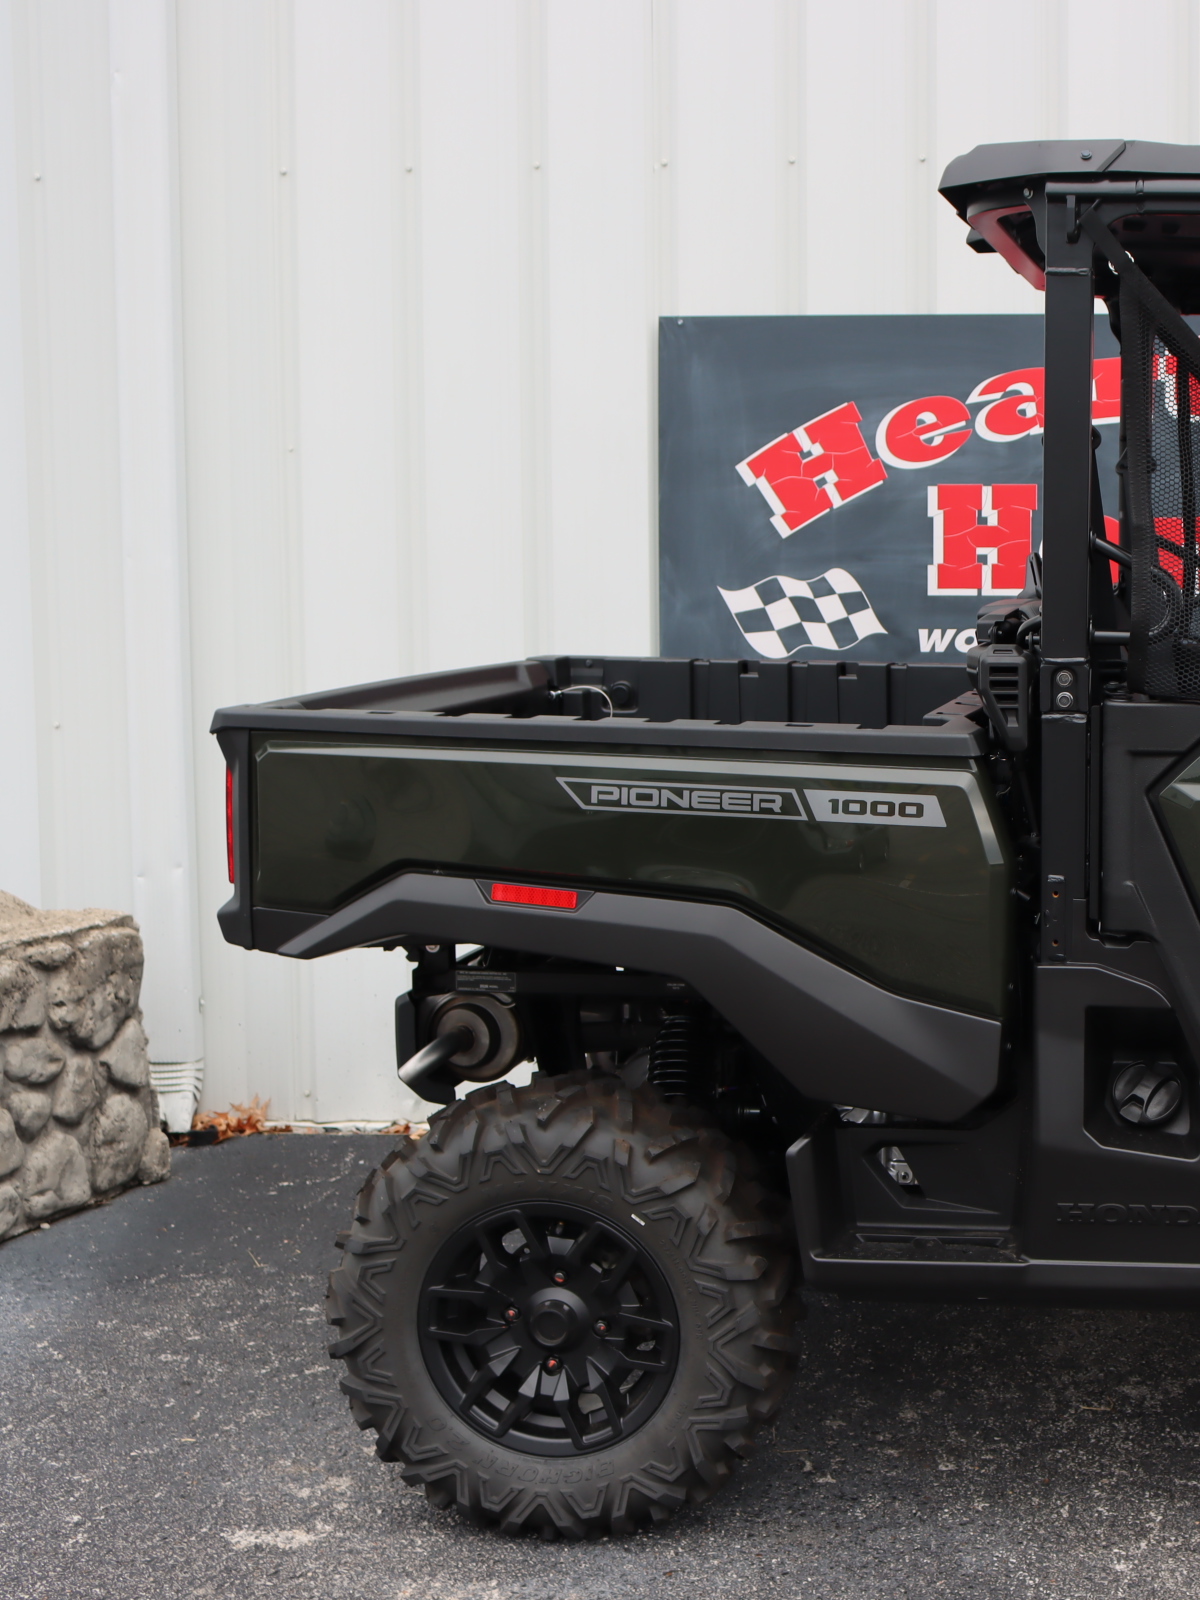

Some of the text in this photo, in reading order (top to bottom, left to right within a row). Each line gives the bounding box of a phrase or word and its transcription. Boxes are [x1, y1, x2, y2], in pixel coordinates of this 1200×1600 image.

[590, 785, 925, 819] PIONEER 1000
[472, 1454, 616, 1485] BIGHORN
